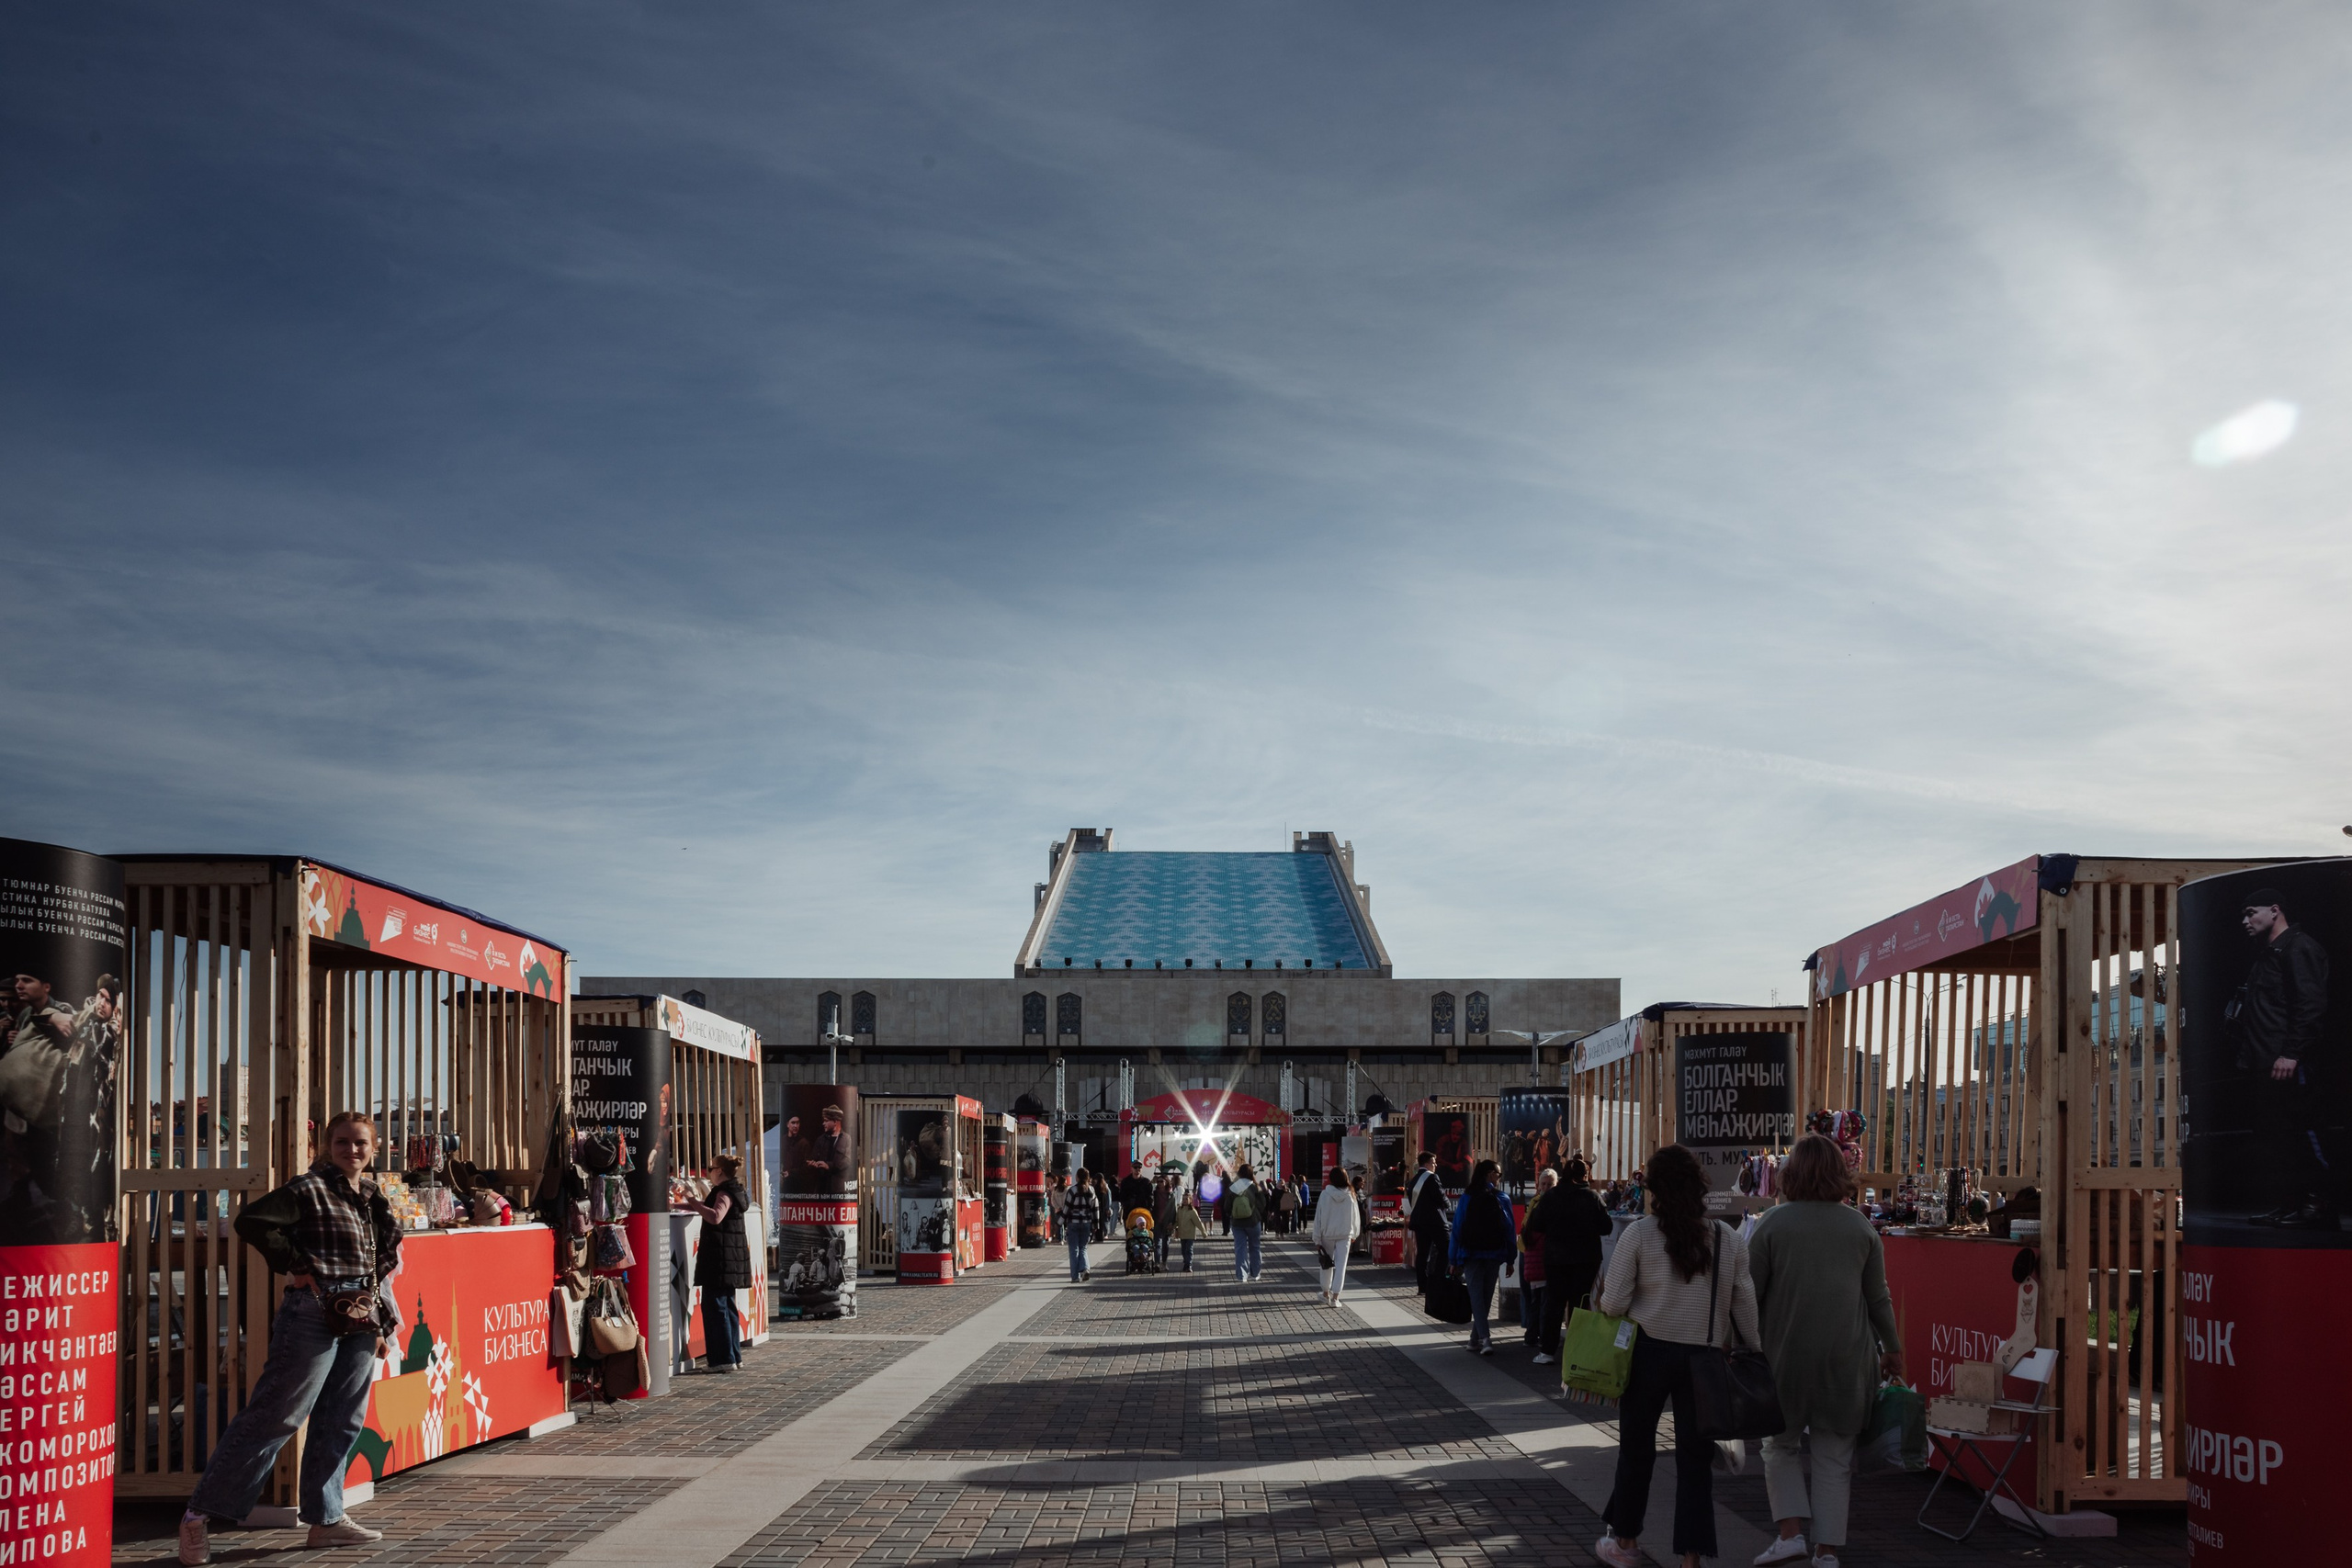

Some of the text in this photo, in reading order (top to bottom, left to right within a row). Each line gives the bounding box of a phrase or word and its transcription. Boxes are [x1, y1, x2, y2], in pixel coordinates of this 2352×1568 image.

[2, 892, 110, 918] СТИКА НУРБӘК БАТУЛЛА
[3, 878, 50, 892] ТЮМНАР
[55, 885, 88, 899] БУЕНЧА
[90, 892, 113, 906] РӘССАМ
[37, 908, 74, 921] БУЕНЧА
[77, 914, 105, 928] РӘССАМ
[38, 922, 75, 936] БУЕНЧА
[80, 929, 107, 942] РӘССАМ
[1684, 1063, 1785, 1089] БОЛГАНЧЫК
[1685, 1088, 1738, 1114] ЕЛЛАР.
[780, 1206, 836, 1222] ЛГАНЧЫК
[4, 1270, 108, 1299] ЕЖИССЕР
[6, 1305, 74, 1332] ӘРИТ
[484, 1298, 550, 1333] КУЛЬТУРА
[485, 1328, 548, 1365] БИЗНЕСА
[1932, 1323, 2001, 1363] КУЛЬТУР
[2184, 1314, 2235, 1367] ЧЫК
[1, 1368, 86, 1399] ӘССАМ
[0, 1394, 85, 1432] ЕРГЕЙ
[0, 1526, 86, 1566] ИПОВА
